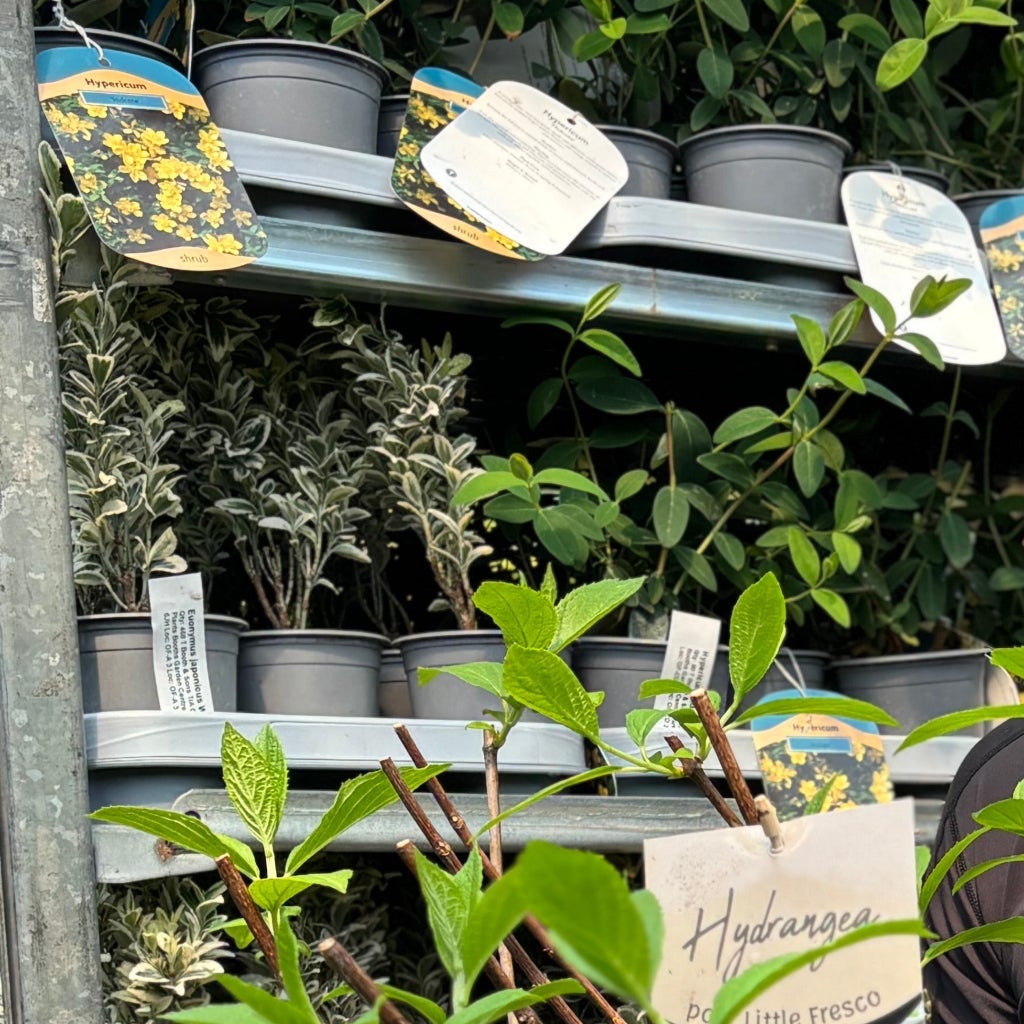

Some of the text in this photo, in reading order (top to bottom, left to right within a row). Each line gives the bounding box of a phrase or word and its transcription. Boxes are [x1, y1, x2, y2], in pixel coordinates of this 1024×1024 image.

[85, 78, 147, 90] Hypericum
[453, 224, 479, 242] shrub
[180, 254, 209, 263] shrub
[187, 609, 196, 656] Euonymus
[174, 660, 182, 686] Garden
[178, 688, 186, 711] Centre
[184, 676, 192, 694] Sons
[188, 658, 203, 704] japonicus
[793, 723, 840, 733] Hyericum
[682, 887, 880, 984] Hydrangea
